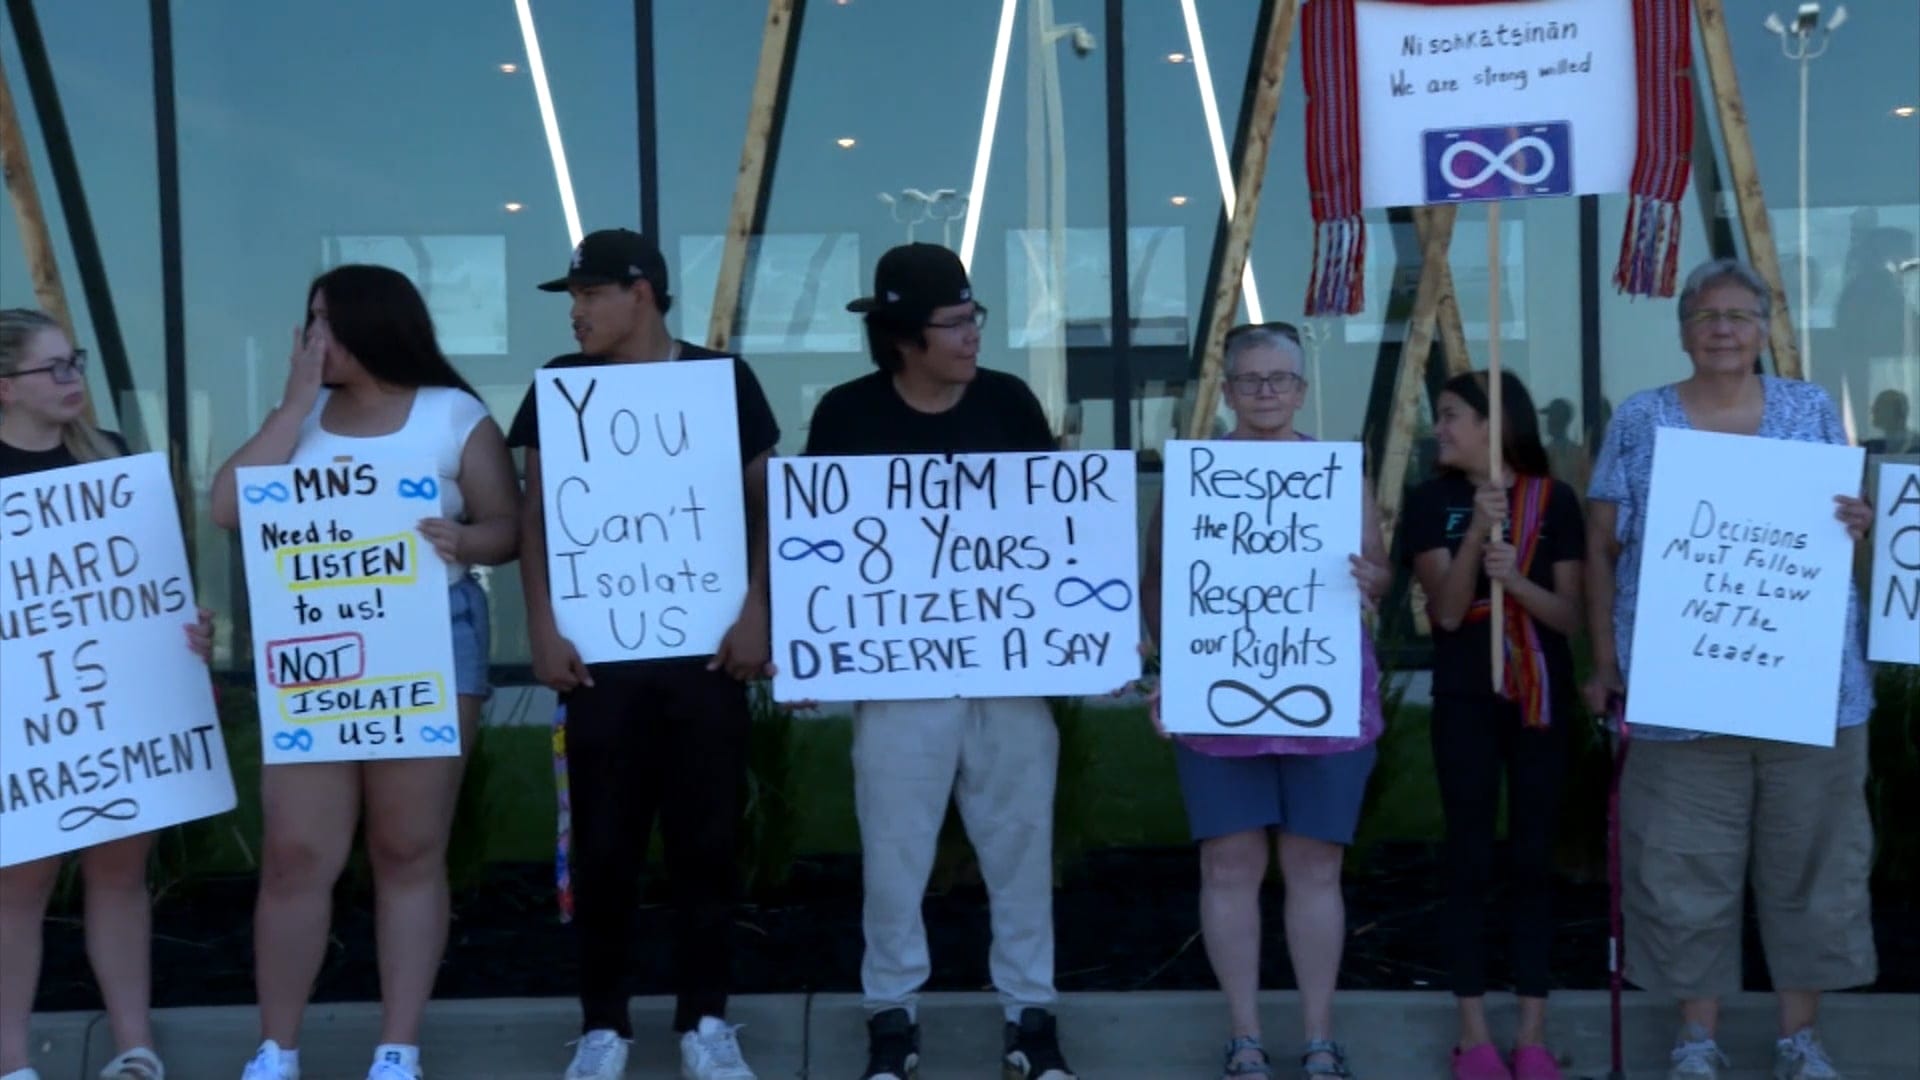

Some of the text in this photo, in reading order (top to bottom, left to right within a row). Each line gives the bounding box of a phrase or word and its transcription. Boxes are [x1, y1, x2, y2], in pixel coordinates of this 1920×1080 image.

[1390, 51, 1592, 97] We are strong willed
[0, 472, 135, 541] SKING
[292, 462, 379, 504] MNS
[782, 452, 1120, 522] NO AGM FOR
[1189, 446, 1344, 528] Respect
[261, 519, 354, 553] Need to
[555, 474, 707, 548] Can't
[1191, 511, 1324, 556] the Roots
[1689, 499, 1808, 550] Decisions
[9, 535, 140, 601] HARD
[292, 540, 407, 583] LISTEN
[554, 549, 723, 600] Isolate
[852, 515, 895, 586] 8
[1743, 548, 1822, 581] Follow
[0, 576, 187, 642] UESTIONS
[292, 587, 388, 626] to us!
[806, 582, 1036, 636] CITIZENS
[1188, 558, 1326, 634] Respect
[1757, 578, 1811, 602] Law
[1731, 604, 1778, 633] The
[37, 639, 109, 702] IS
[277, 642, 357, 685] NOT
[789, 626, 1112, 682] DESERVE A SAY
[1231, 625, 1338, 681] Rights
[1692, 632, 1785, 669] Leader
[290, 680, 437, 716] ISOLATE
[23, 701, 108, 747] NOT
[0, 724, 216, 815] ARASSMENT
